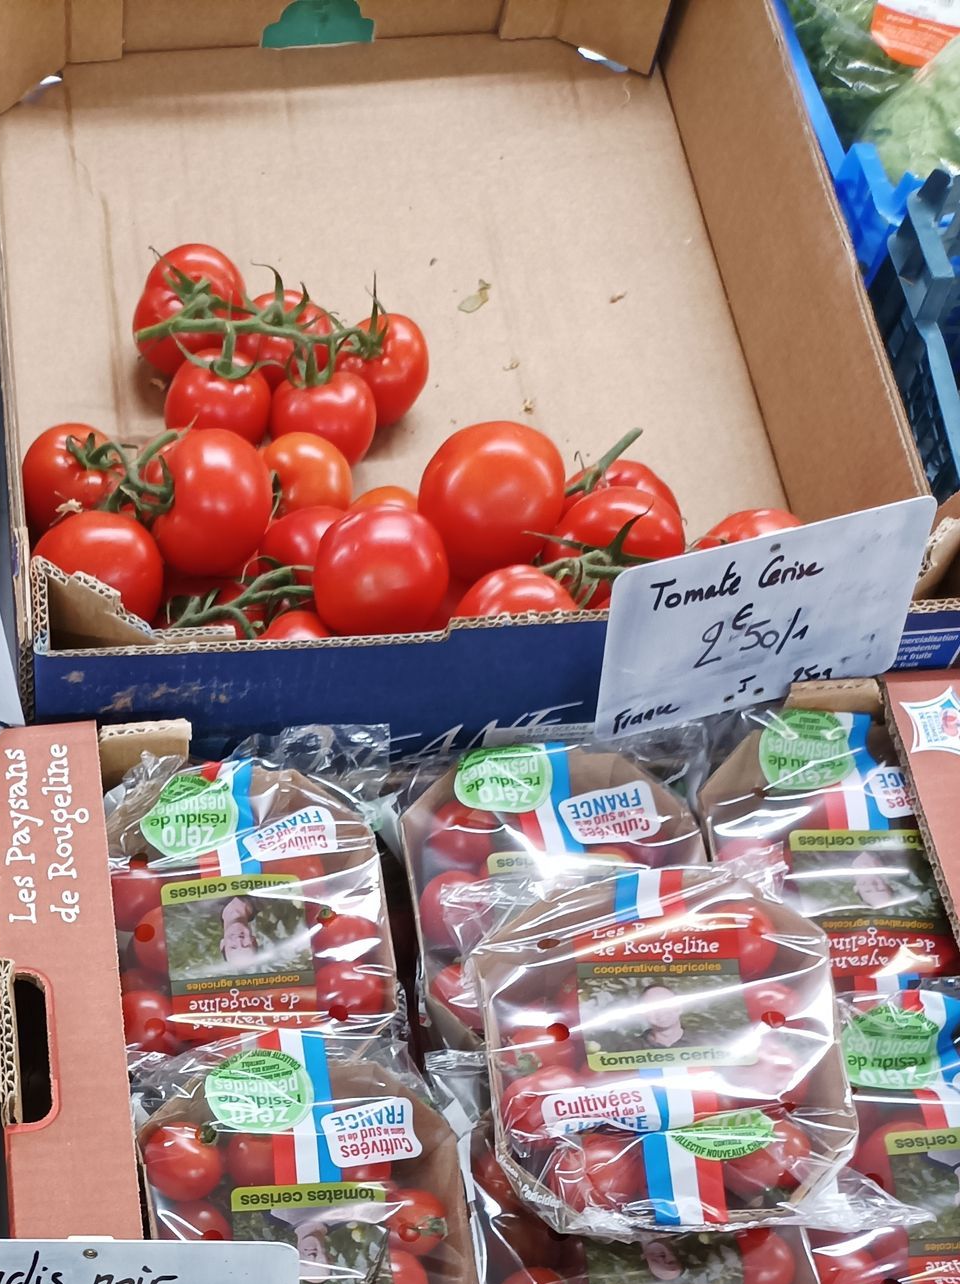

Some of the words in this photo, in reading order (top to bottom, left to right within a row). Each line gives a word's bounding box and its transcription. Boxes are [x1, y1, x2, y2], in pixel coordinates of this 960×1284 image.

[650, 561, 742, 611] Tomate
[4, 748, 44, 866] Paysans
[41, 743, 90, 881] Rougeline
[567, 788, 642, 820] FRANCE
[8, 875, 37, 924] Les
[169, 881, 228, 899] cerises
[50, 889, 80, 923] de
[623, 936, 720, 963] Rougeline
[189, 988, 274, 1014] Rougeline
[280, 992, 300, 1010] de
[598, 1050, 675, 1066] tomates
[847, 1054, 868, 1070] de
[553, 1090, 643, 1117] Cultivées
[622, 1106, 635, 1116] de
[636, 1104, 646, 1113] la
[361, 1127, 383, 1140] sud
[894, 1133, 958, 1150] cerises
[340, 1136, 414, 1160] Cultivées
[240, 1190, 304, 1207] cerises
[307, 1187, 376, 1202] tomates
